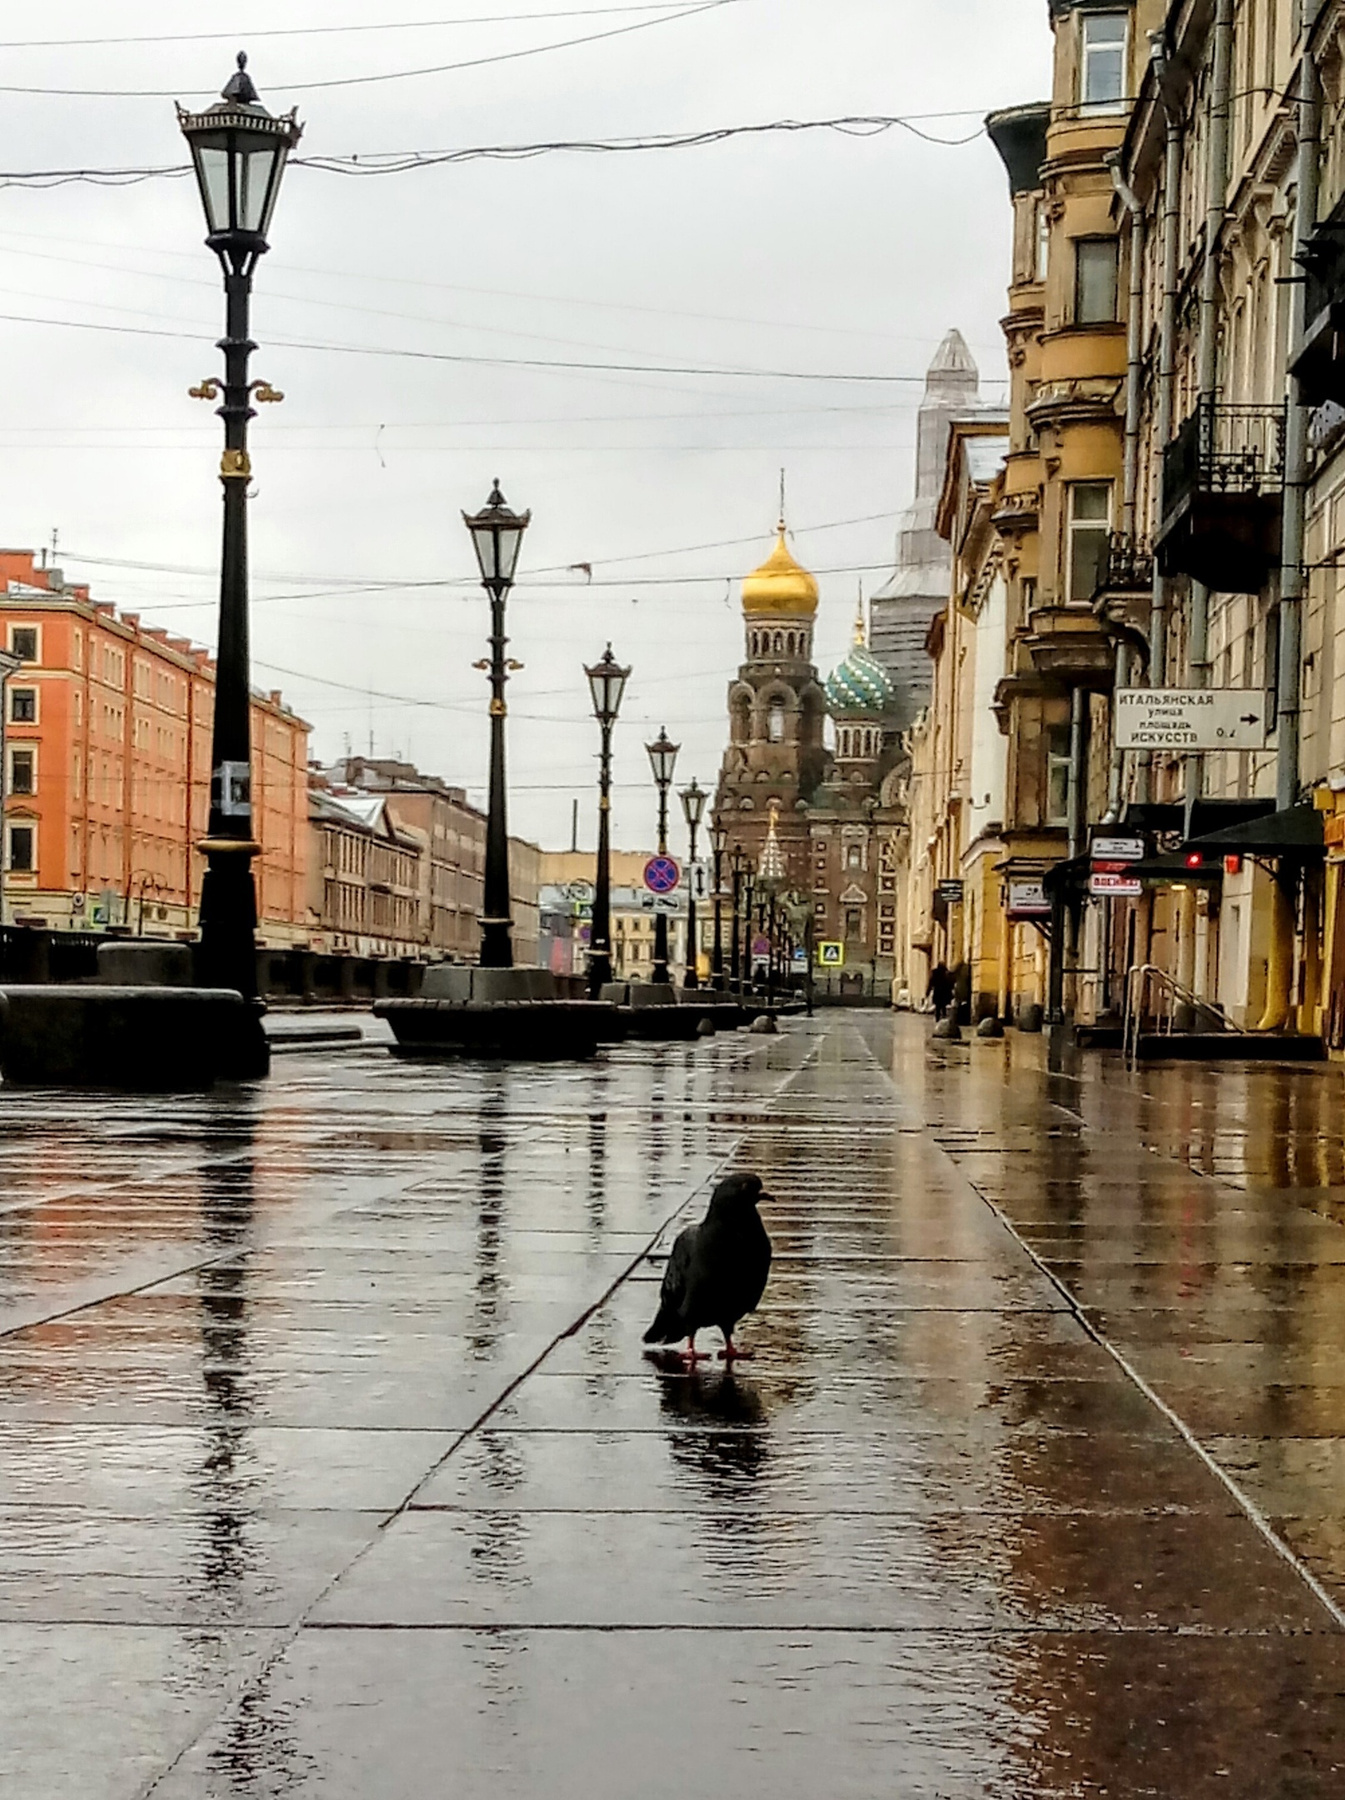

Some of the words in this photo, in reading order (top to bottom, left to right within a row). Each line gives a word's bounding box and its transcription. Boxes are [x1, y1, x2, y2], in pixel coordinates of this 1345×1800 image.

[1119, 694, 1214, 705] ИТАЛЬЯНСКАЯ
[1148, 708, 1183, 718] улица
[1139, 721, 1191, 730] площадь
[1131, 733, 1198, 743] ИСКУССТВ
